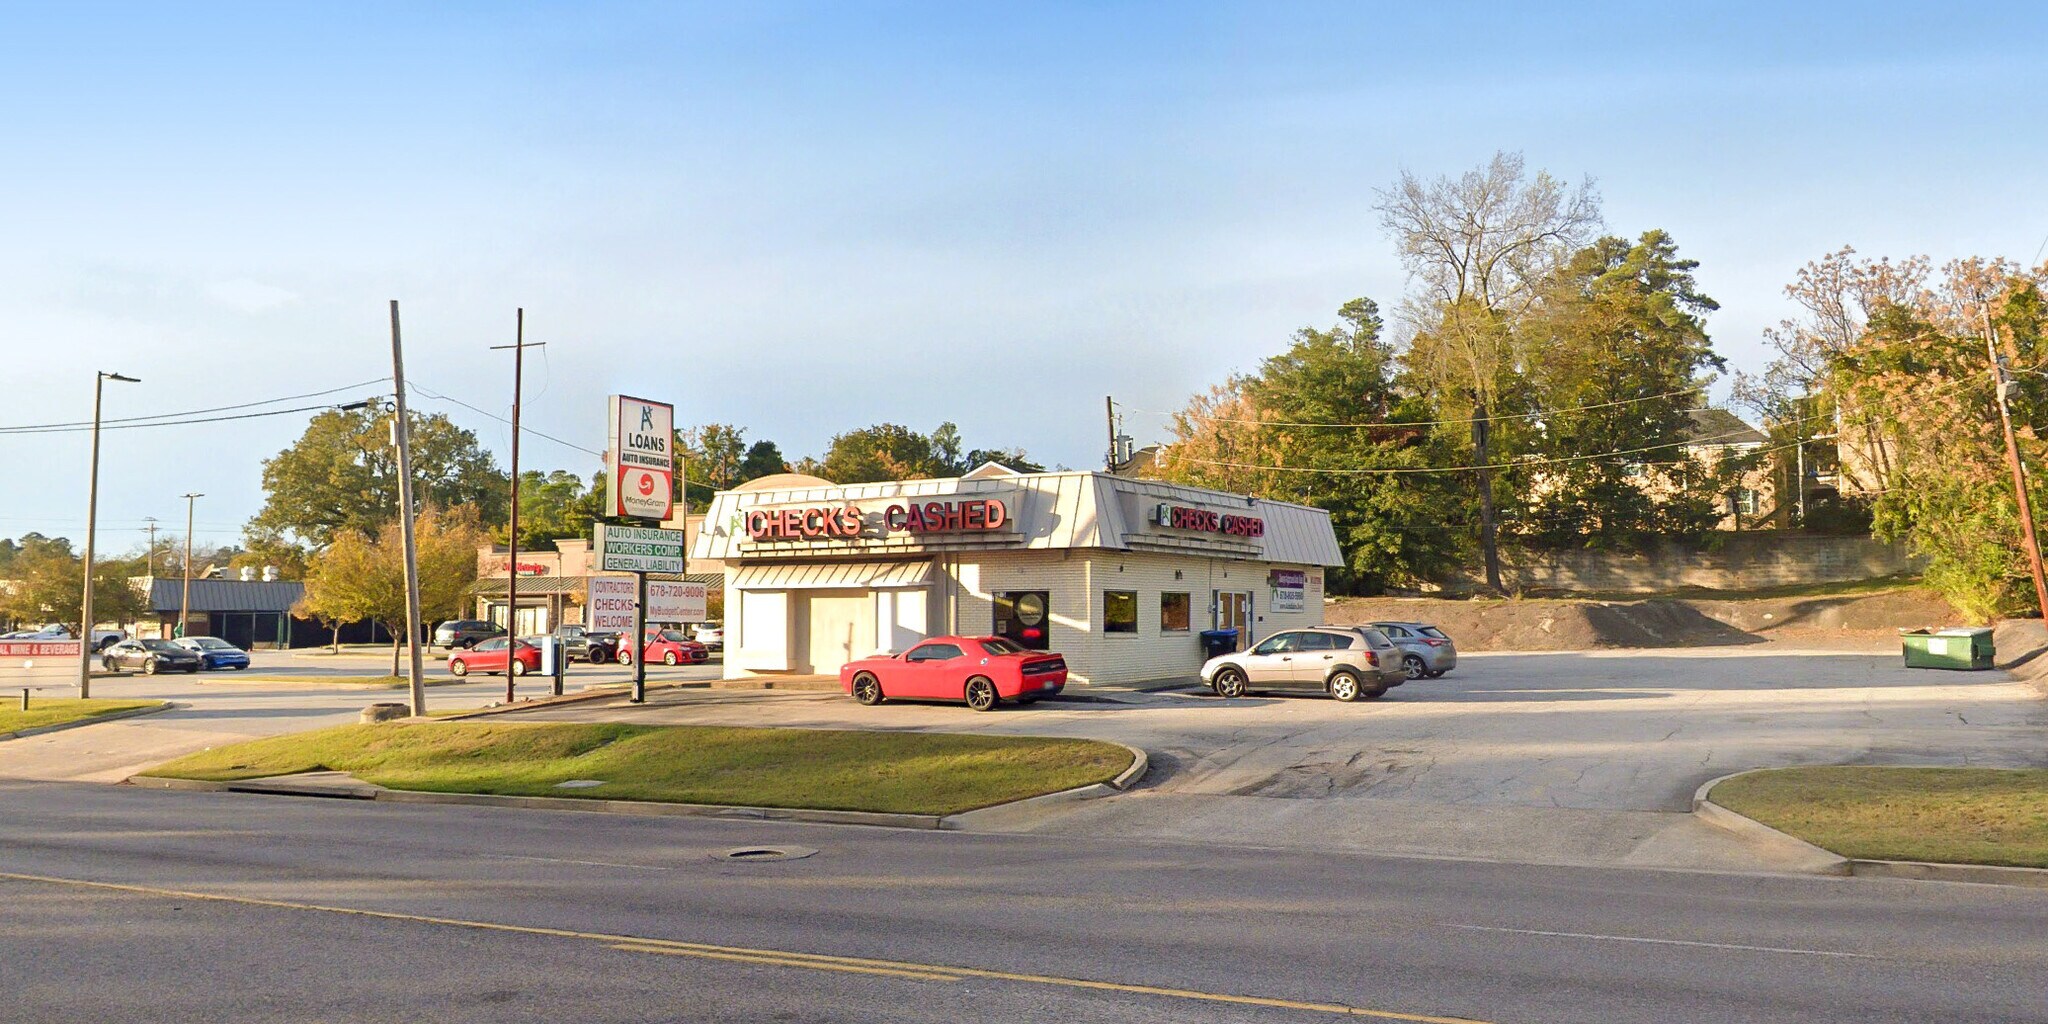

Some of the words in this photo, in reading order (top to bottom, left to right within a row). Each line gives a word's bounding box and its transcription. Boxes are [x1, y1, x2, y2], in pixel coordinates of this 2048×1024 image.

[629, 432, 665, 452] LOANS
[622, 453, 638, 463] AUTO
[639, 455, 670, 468] INSURANCE
[625, 496, 666, 507] MoneyGram
[748, 505, 862, 538] CHECKS
[884, 498, 1006, 532] CASHED
[1171, 506, 1219, 532] CHECKS
[1224, 514, 1265, 537] CASHED
[607, 527, 632, 539] AUTO
[633, 530, 681, 543] INSURANCE
[607, 542, 653, 555] WORKERS
[655, 546, 681, 557] COMP.
[607, 557, 644, 570] GENERAL
[646, 560, 680, 571] LIABILITY
[595, 581, 634, 594] CONTRACTORS
[650, 584, 704, 598] 678-720-9006
[594, 598, 634, 611] CHECKS
[595, 615, 633, 628] WELCOME
[10, 644, 31, 655] WINE
[32, 644, 39, 655] &
[40, 644, 79, 655] BEVERAGE
